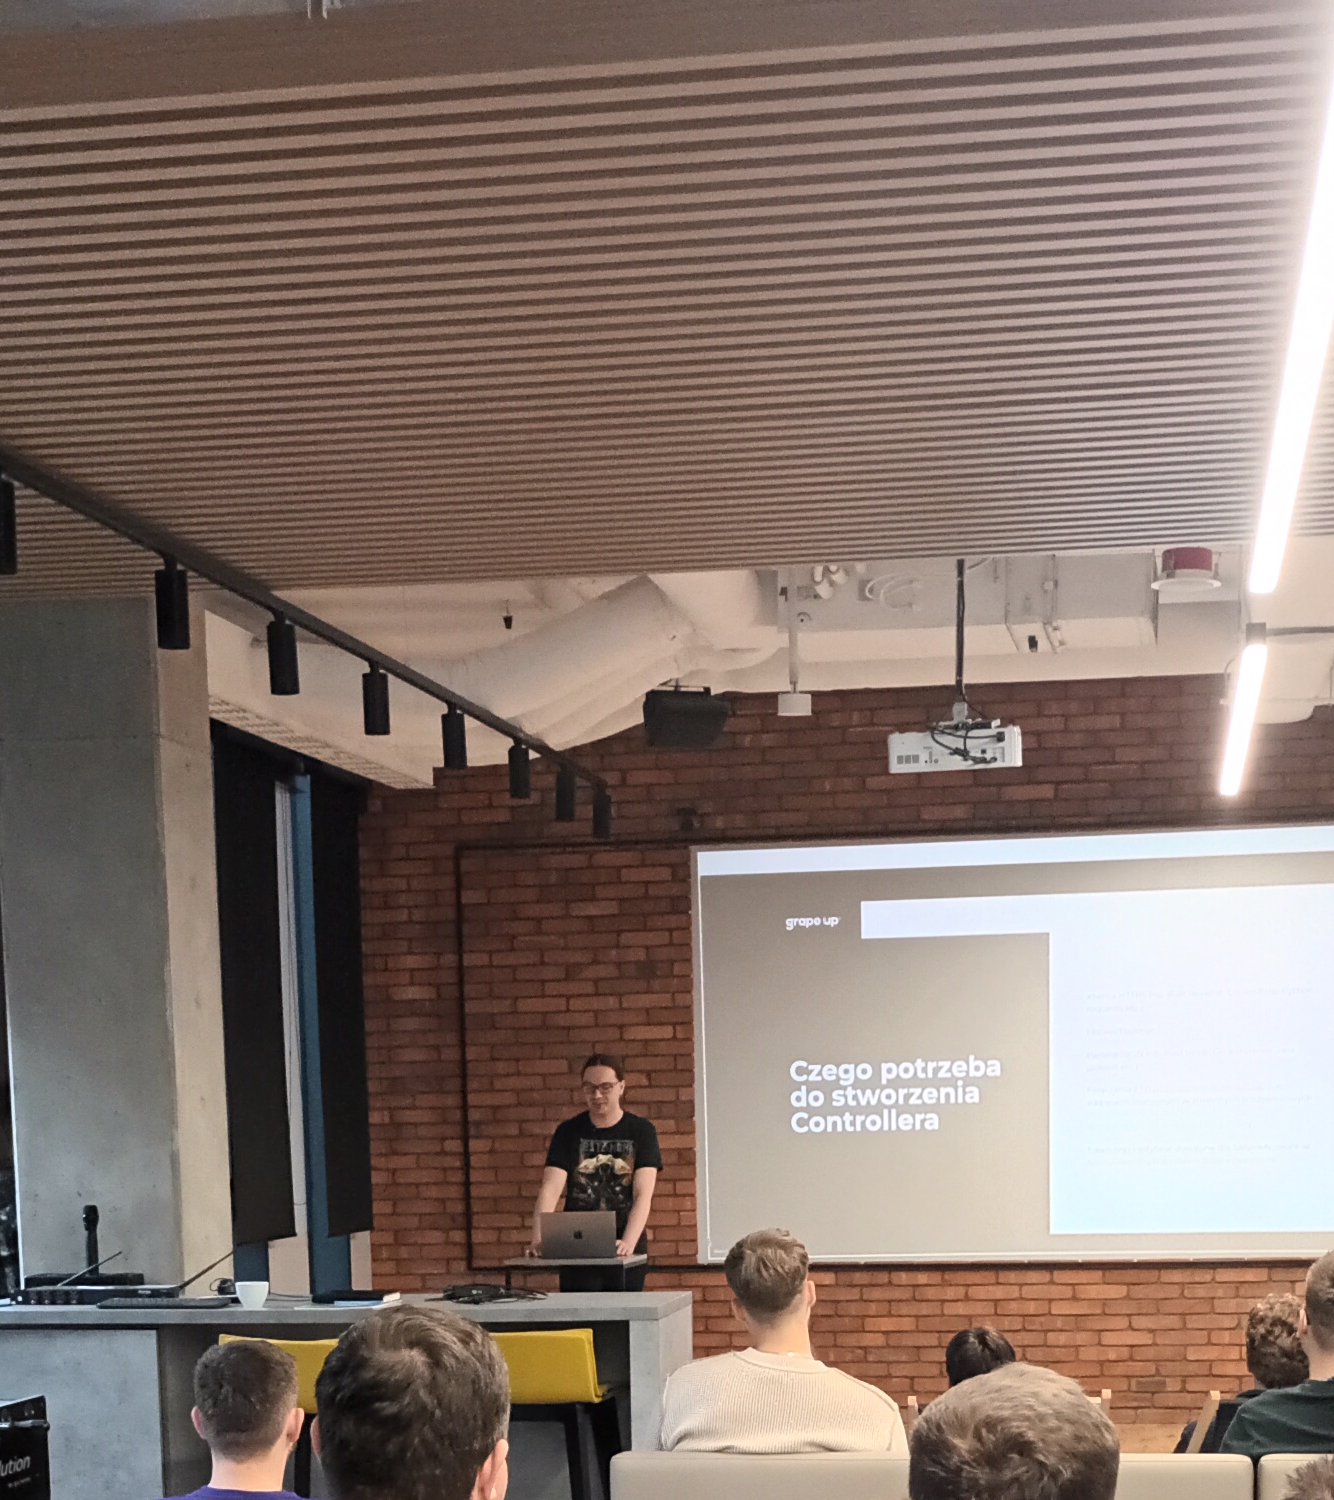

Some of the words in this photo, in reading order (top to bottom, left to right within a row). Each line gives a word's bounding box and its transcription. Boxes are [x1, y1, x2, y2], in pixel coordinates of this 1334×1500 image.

[785, 917, 821, 931] grape
[822, 916, 839, 928] up
[789, 1060, 873, 1086] Czego
[881, 1054, 1002, 1085] potrzeba
[790, 1085, 825, 1108] do
[831, 1080, 980, 1107] stworzenia
[790, 1108, 940, 1133] Controllera
